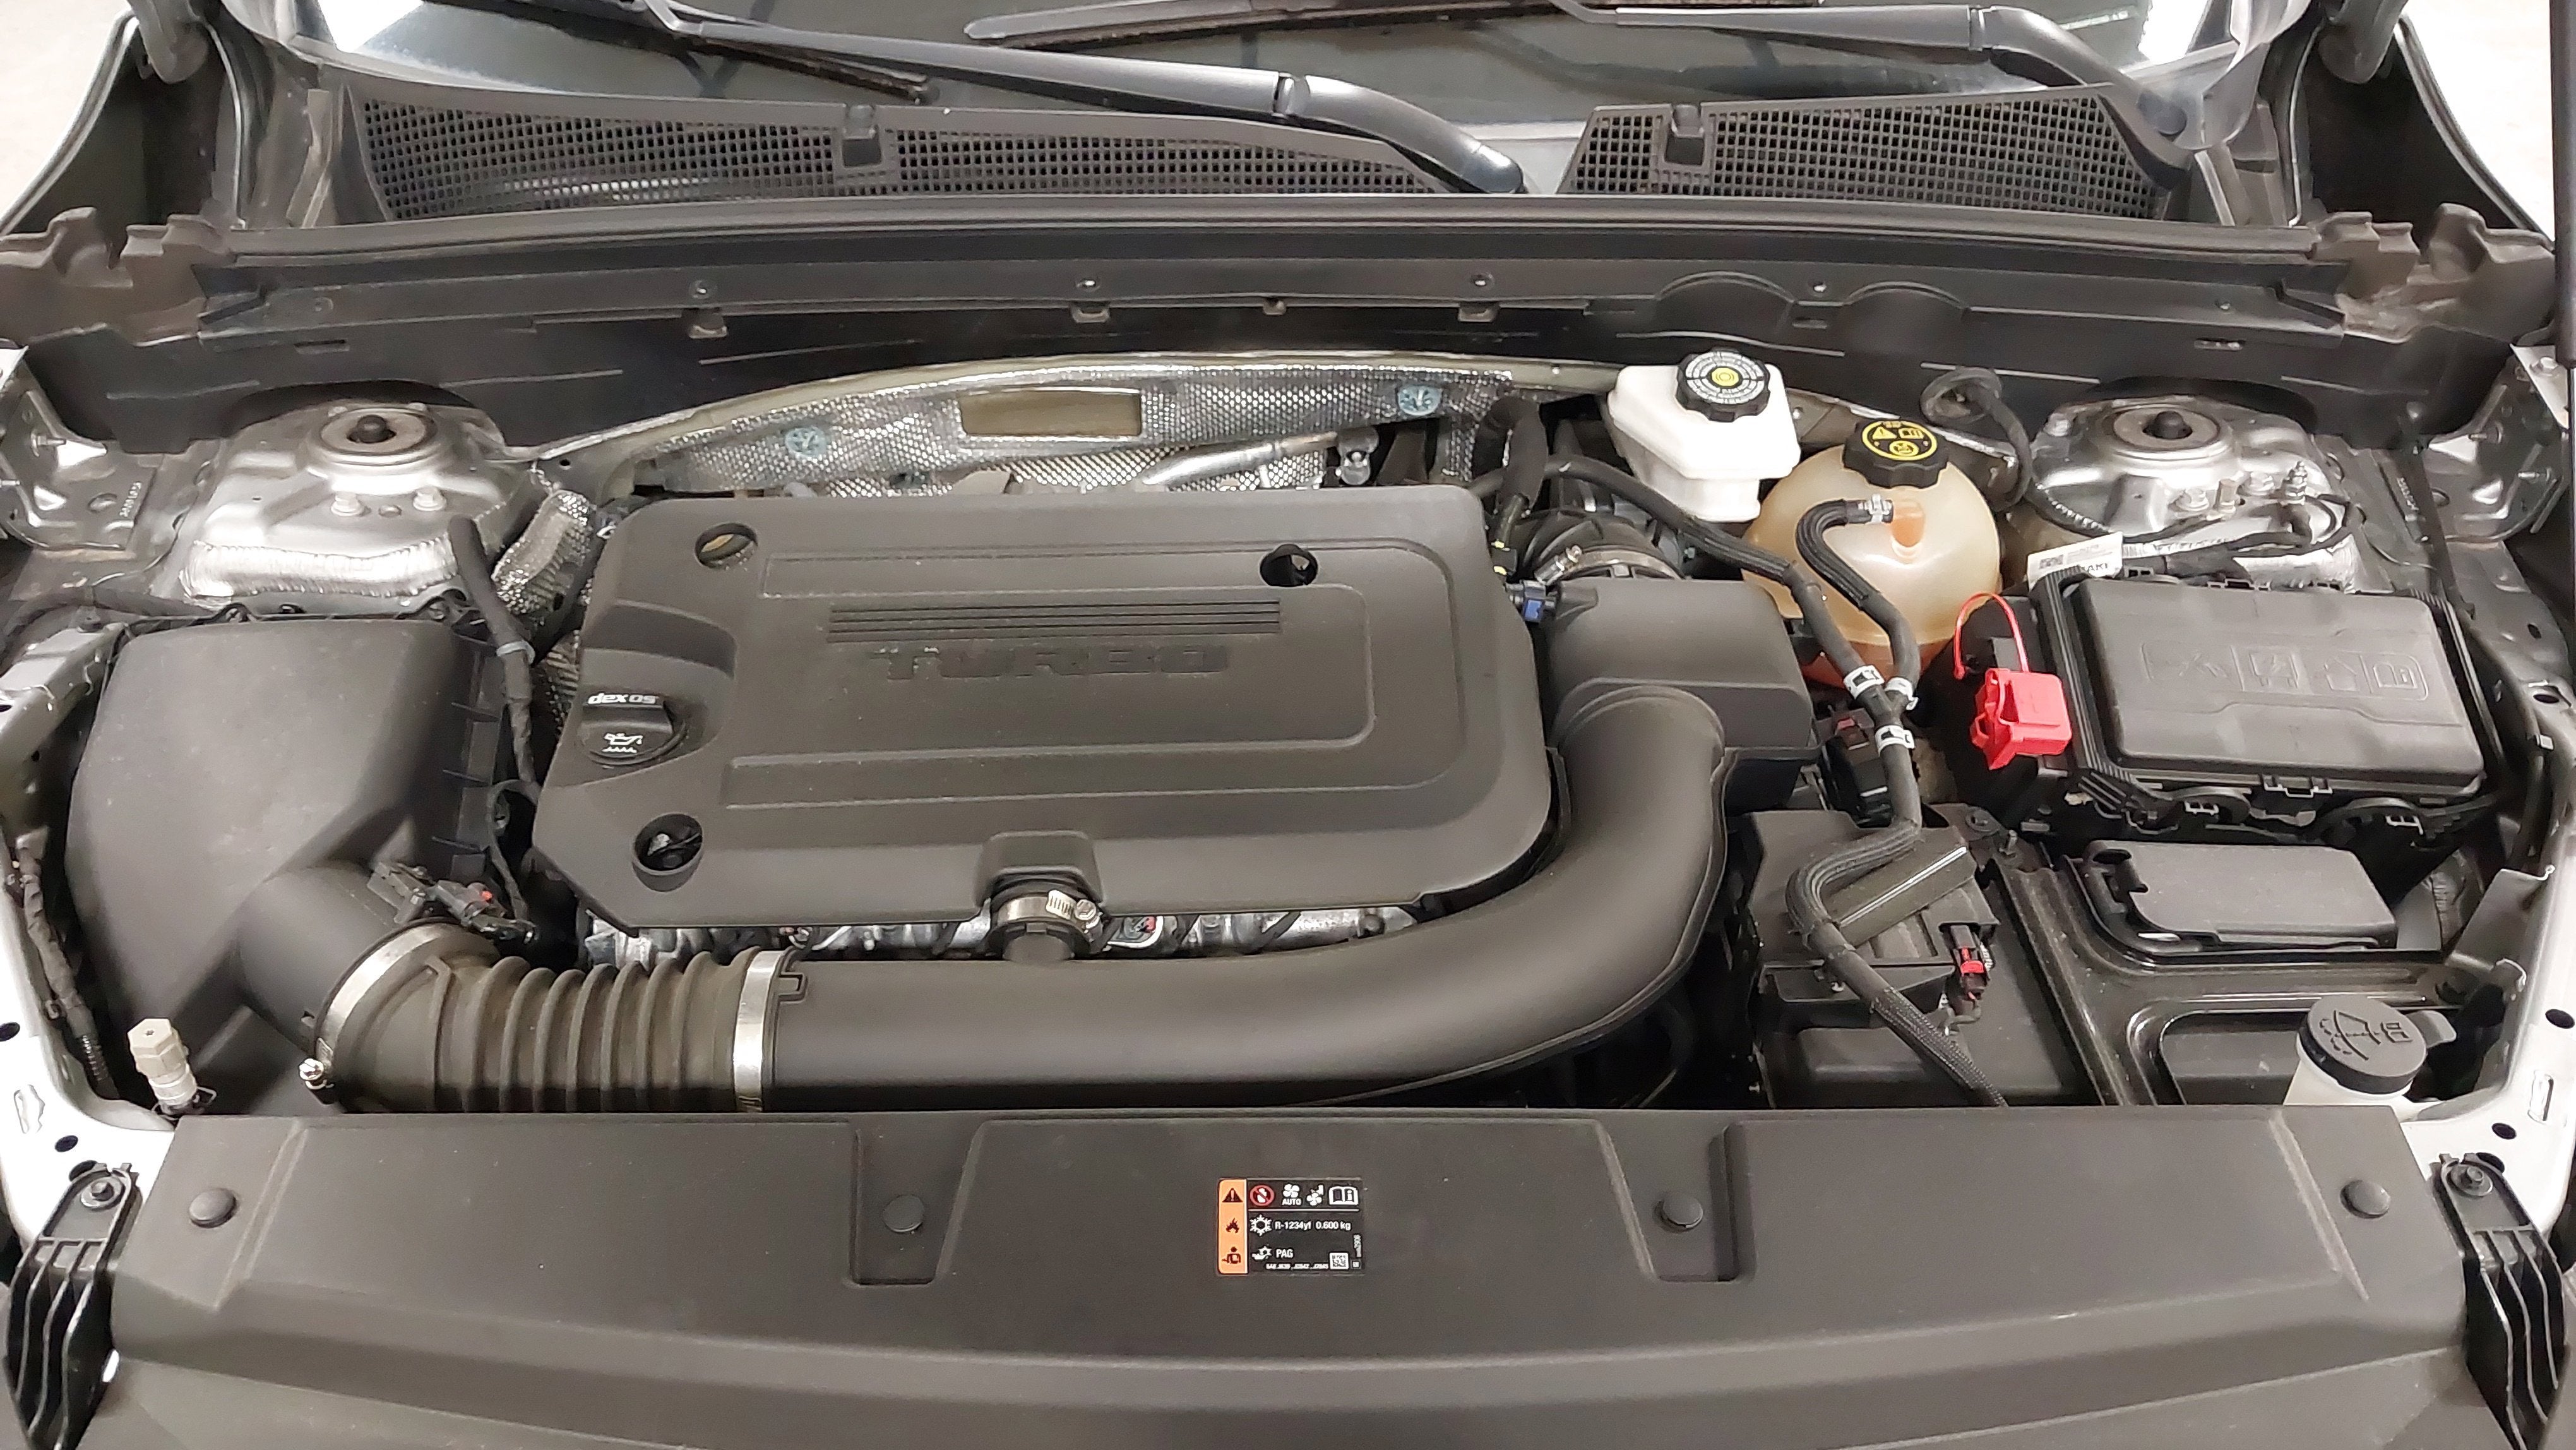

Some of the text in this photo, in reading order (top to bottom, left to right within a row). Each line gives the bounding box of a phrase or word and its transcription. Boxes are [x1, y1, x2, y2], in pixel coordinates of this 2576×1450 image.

[2082, 563, 2108, 572] AKI
[868, 644, 1229, 680] TURBO
[588, 693, 659, 704] dexos
[1275, 1221, 1351, 1231] R-1234yf 0.600 kg
[1276, 1249, 1294, 1259] PAG
